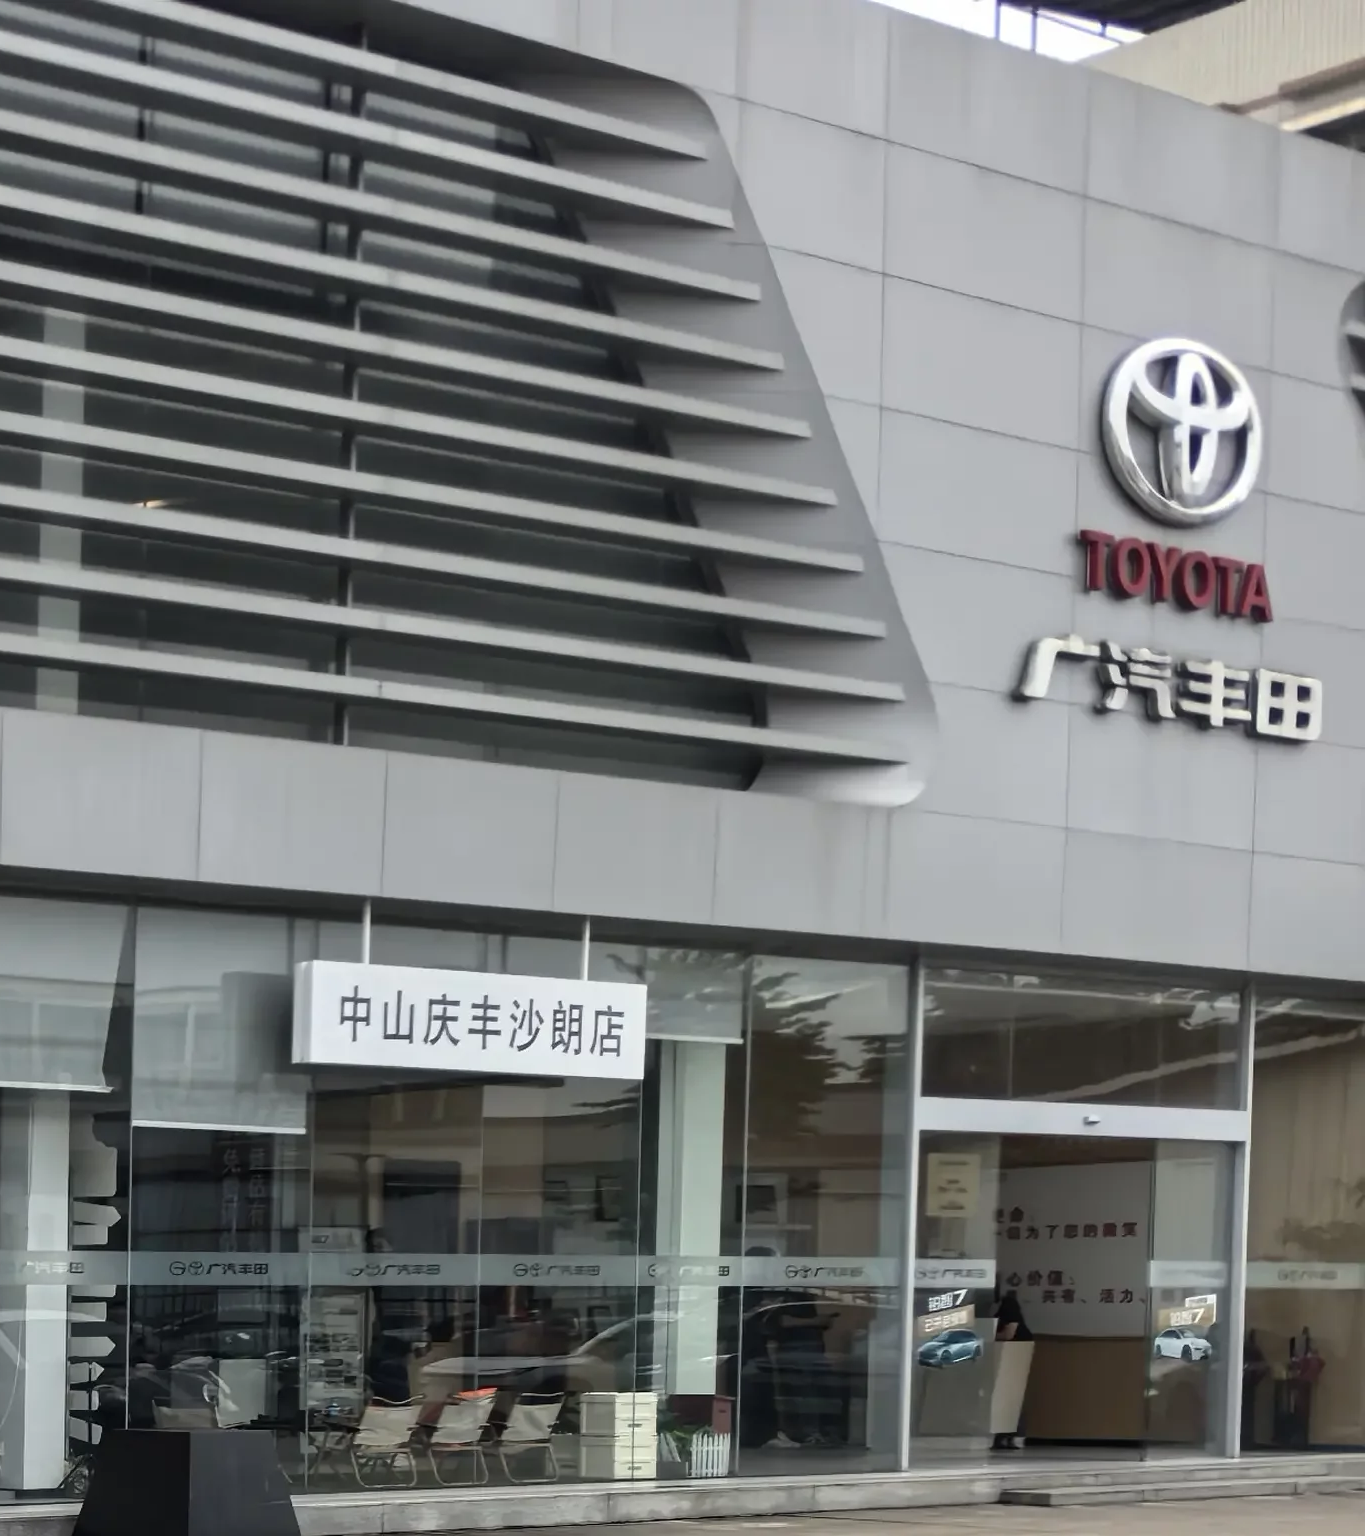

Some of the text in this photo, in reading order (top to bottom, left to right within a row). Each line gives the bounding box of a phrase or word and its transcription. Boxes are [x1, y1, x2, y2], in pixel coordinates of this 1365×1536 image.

[1078, 529, 1273, 622] TOYOTA
[1013, 634, 1322, 741] 广汽丰田
[339, 985, 625, 1057] 中山庆丰沙朗店
